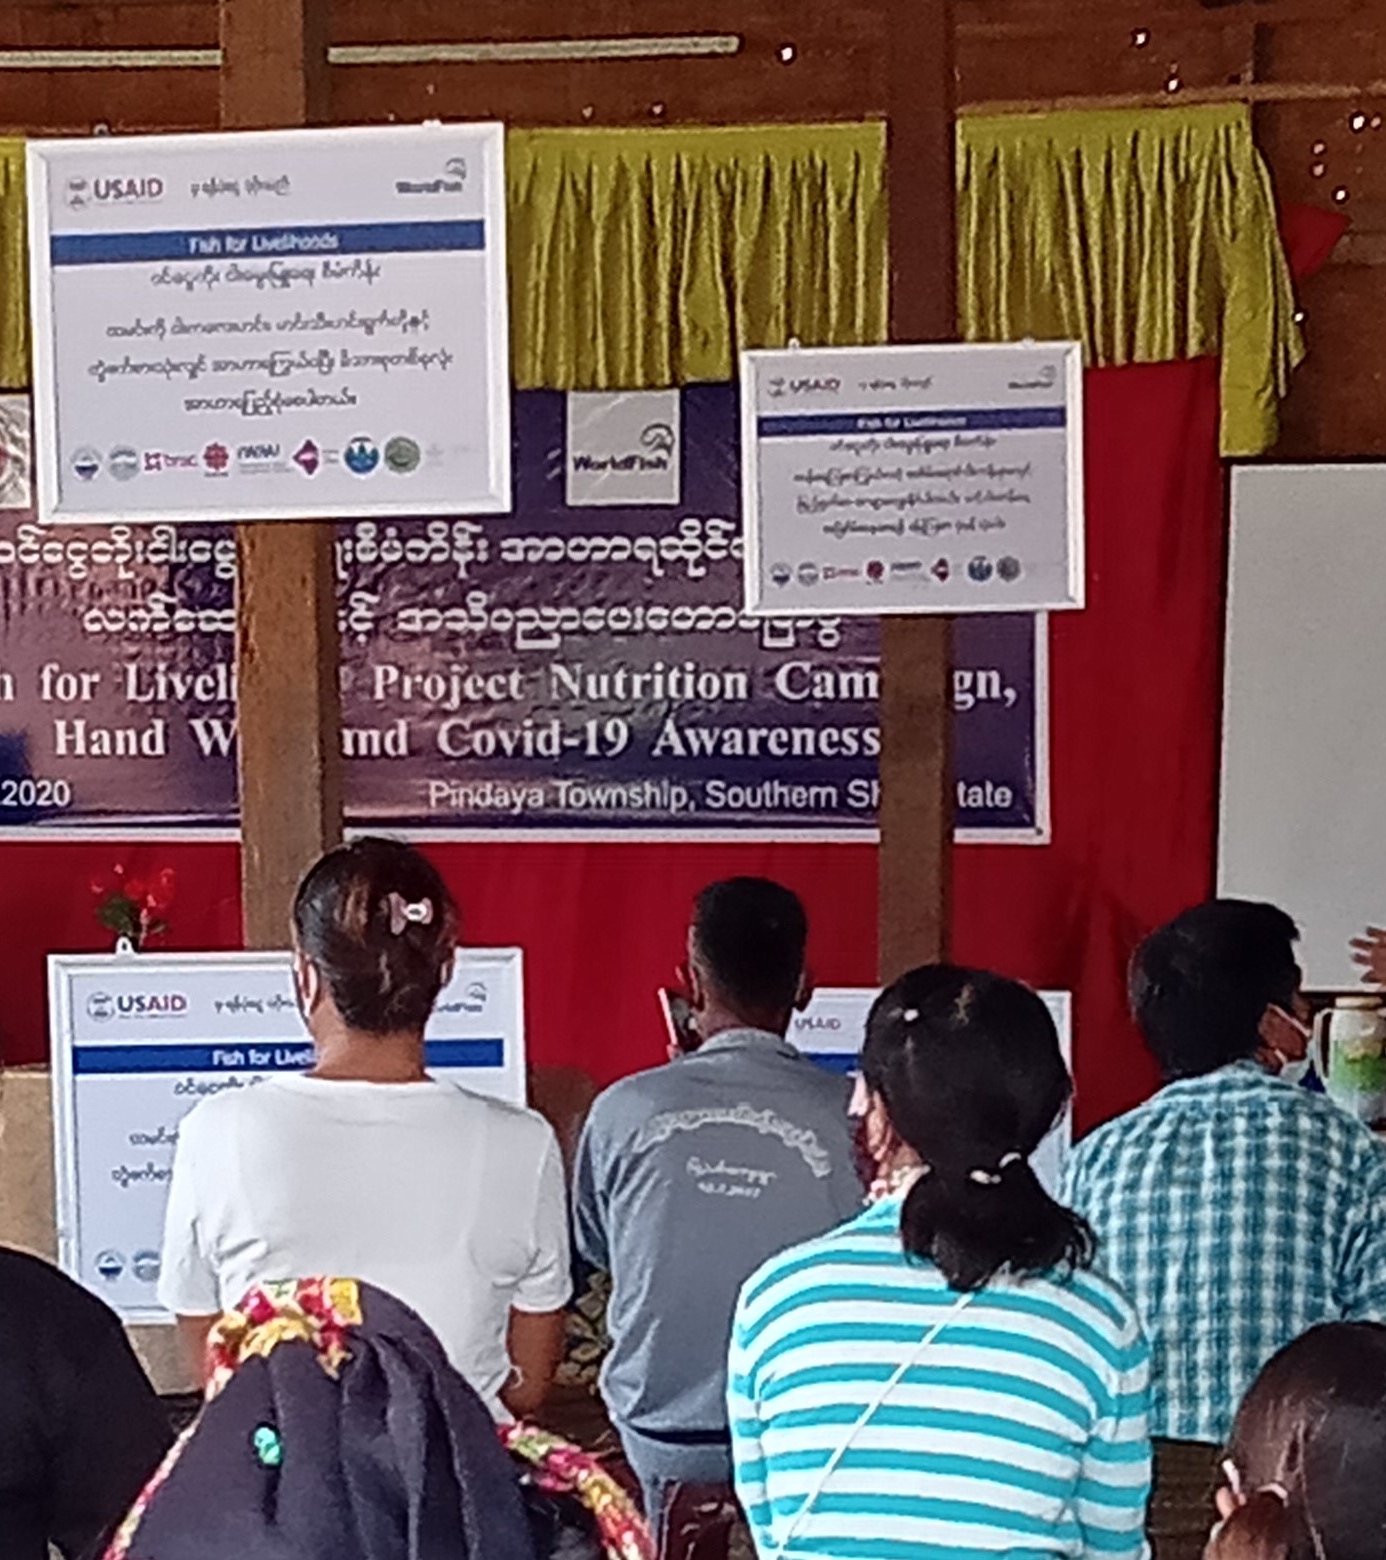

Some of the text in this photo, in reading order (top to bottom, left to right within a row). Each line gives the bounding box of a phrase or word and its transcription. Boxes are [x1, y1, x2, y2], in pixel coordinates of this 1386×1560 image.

[94, 178, 163, 200] USAID
[42, 663, 99, 701] for
[375, 663, 522, 709] Project
[551, 663, 747, 699] Nutrition
[775, 659, 1016, 709] Camgn,
[55, 719, 165, 755] Hand
[438, 719, 628, 756] Covid-19
[654, 719, 880, 755] Awareness
[430, 780, 544, 815] Pindaya
[556, 780, 696, 814] Township,
[706, 780, 838, 808] Southern
[958, 782, 1013, 808] tate
[117, 995, 188, 1013] USAID
[212, 1049, 244, 1066] Fish
[249, 1048, 272, 1066] for
